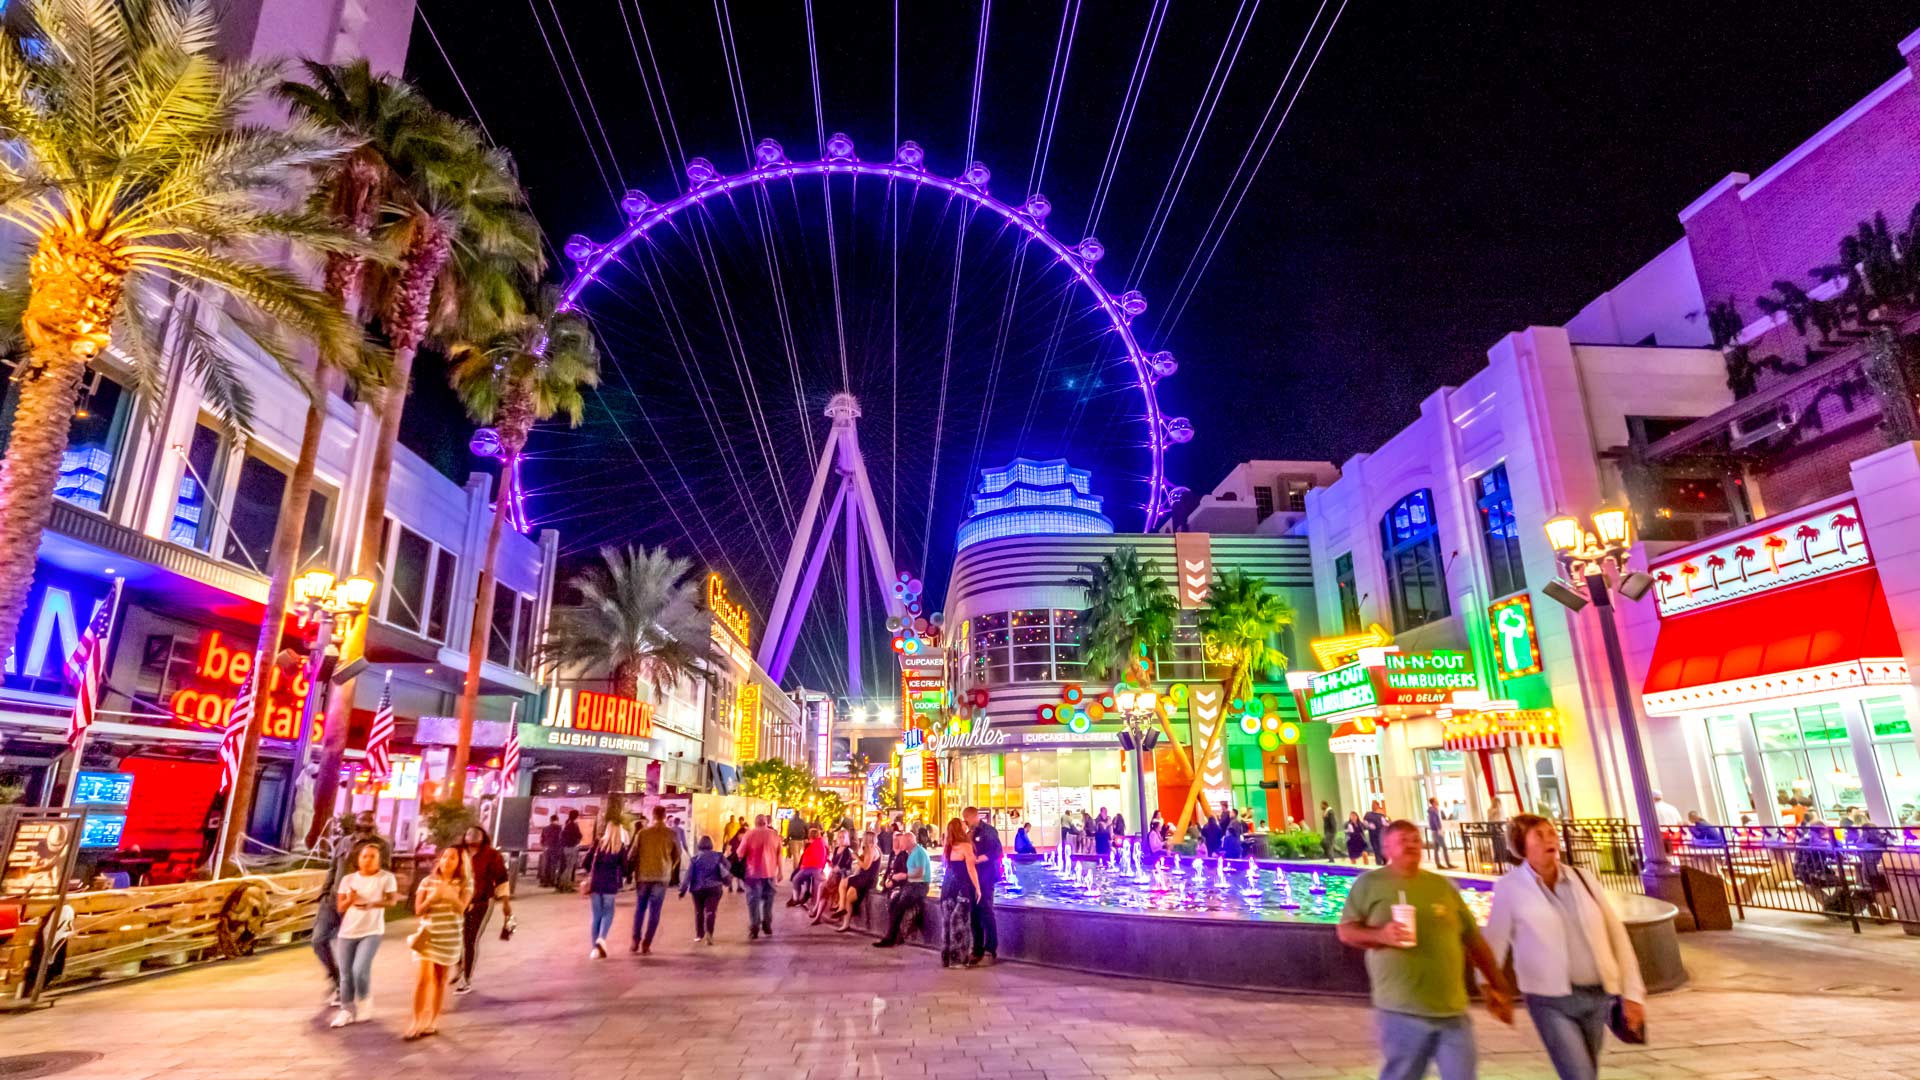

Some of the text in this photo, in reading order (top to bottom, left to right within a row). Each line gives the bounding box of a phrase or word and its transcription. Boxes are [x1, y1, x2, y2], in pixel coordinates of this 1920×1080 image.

[905, 658, 944, 666] CUPCAKES
[1386, 655, 1465, 669] IN-N-OUT
[1313, 667, 1364, 694] IN-N-OUT
[1389, 673, 1477, 688] HAMBURGERS
[1310, 683, 1375, 715] HAMBURGERS
[1398, 693, 1446, 703] NO DELAY
[574, 690, 654, 739] BURRITOS
[548, 732, 650, 752] SUSHI BURRITOS
[927, 716, 1011, 758] Sprinkles
